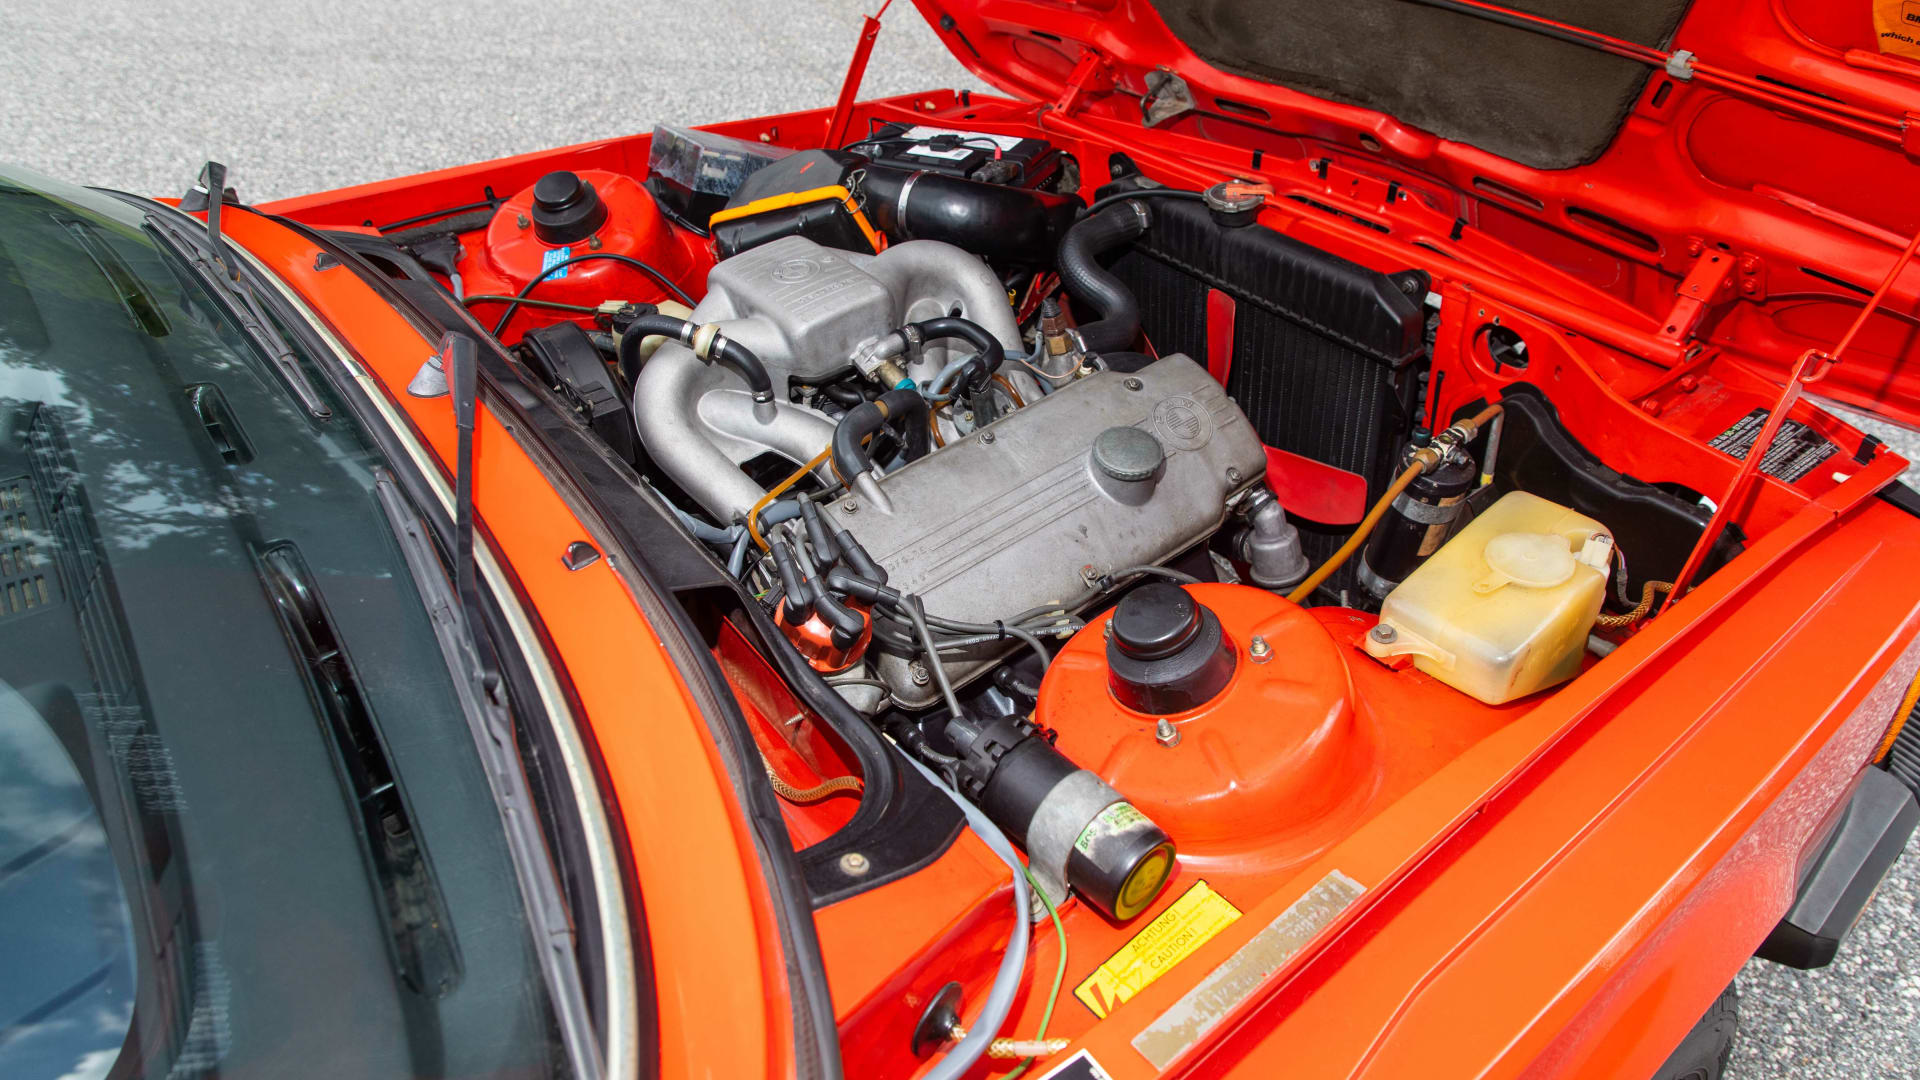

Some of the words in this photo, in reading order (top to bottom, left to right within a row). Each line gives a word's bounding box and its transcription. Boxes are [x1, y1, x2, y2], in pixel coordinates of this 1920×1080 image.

[1881, 32, 1914, 43] which
[1132, 909, 1180, 952] ACHTUNG!
[1150, 927, 1198, 968] CAUTION!
